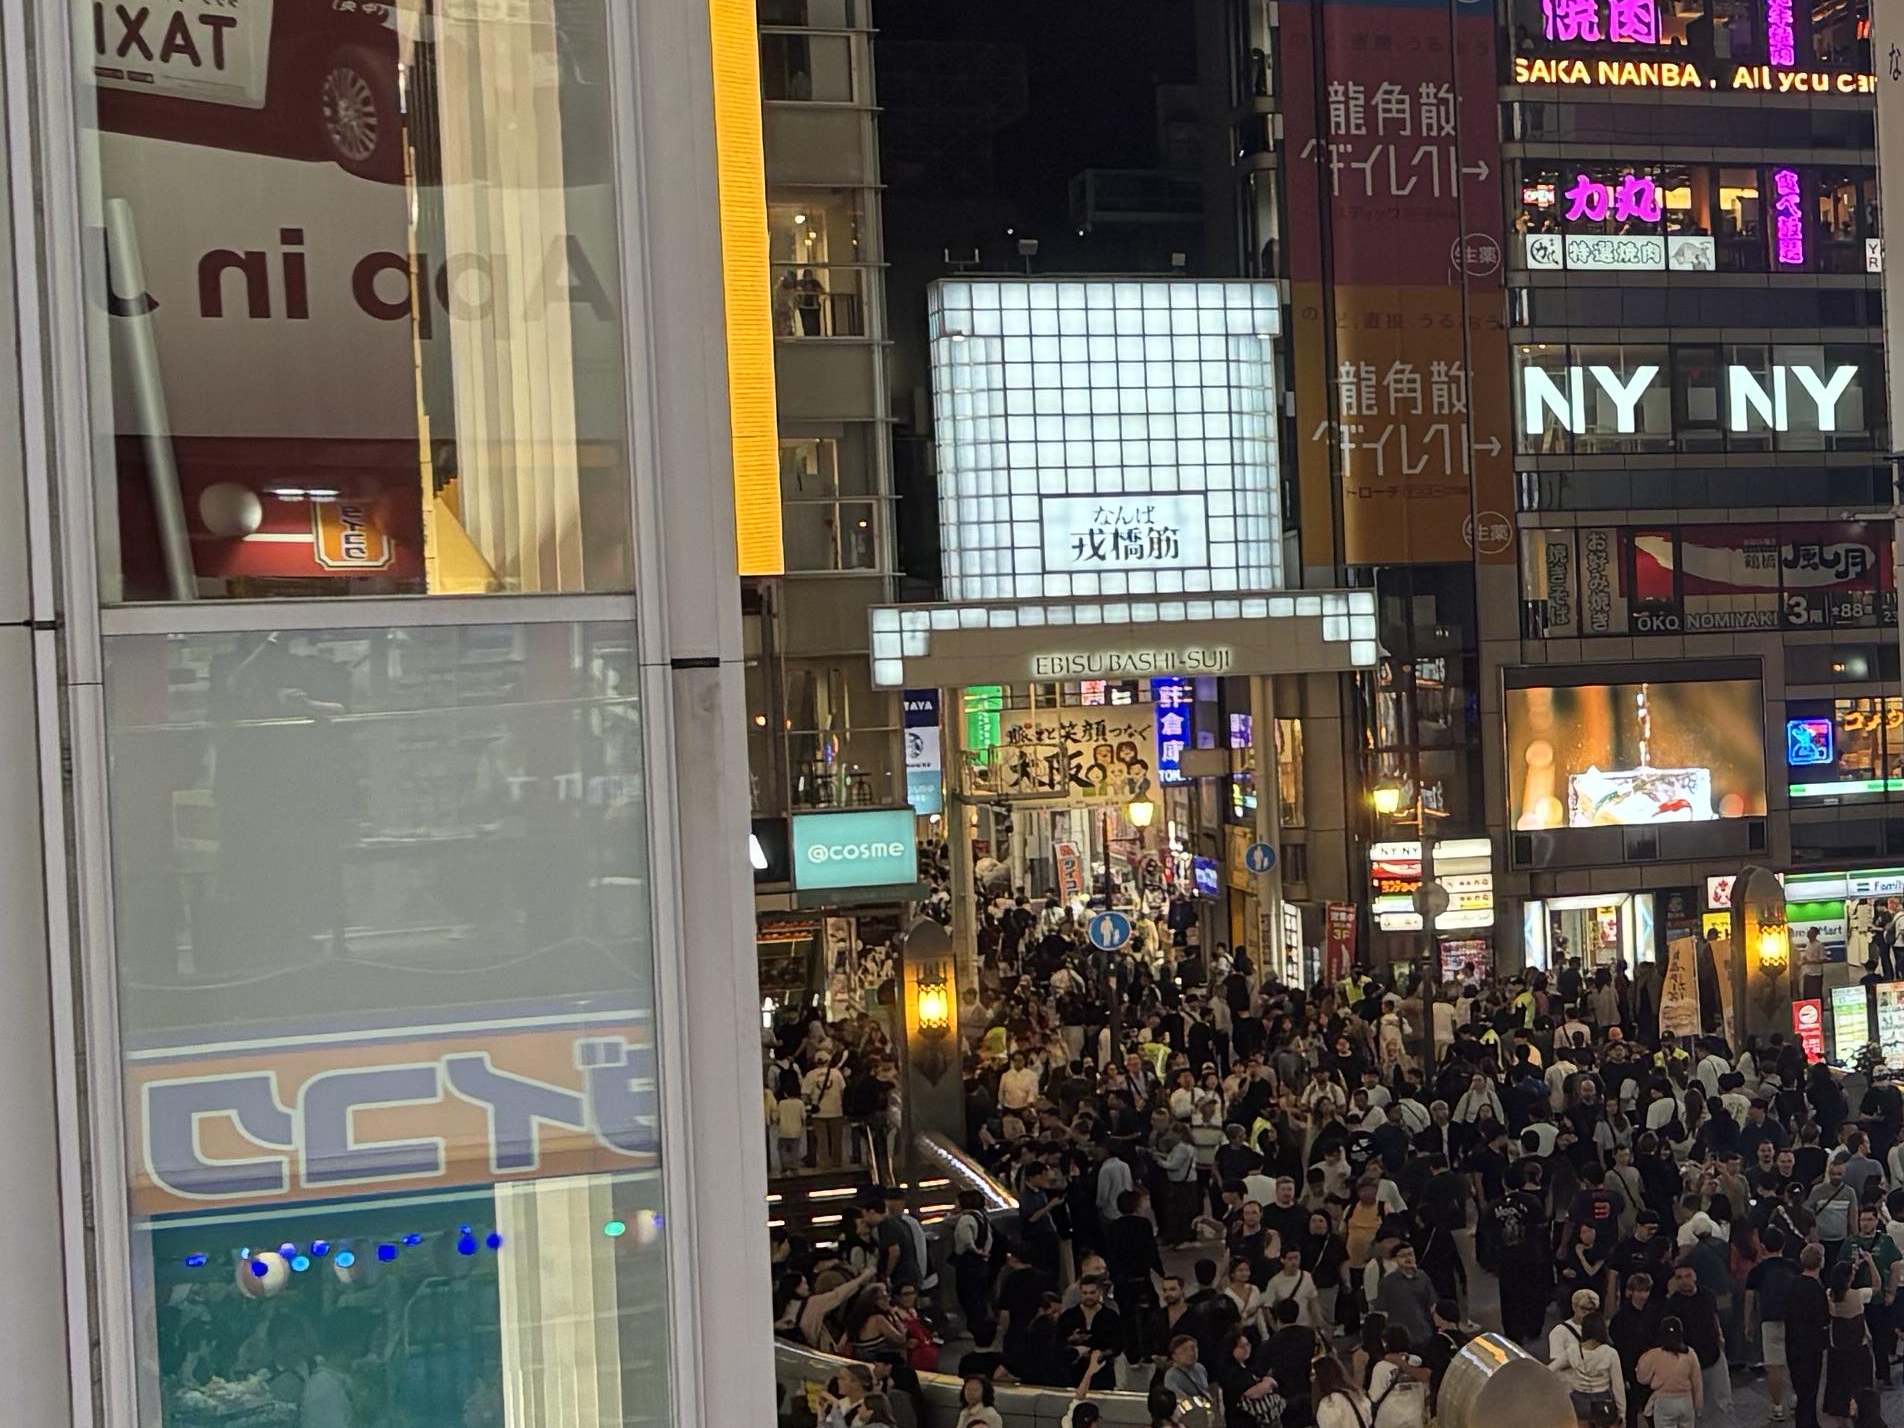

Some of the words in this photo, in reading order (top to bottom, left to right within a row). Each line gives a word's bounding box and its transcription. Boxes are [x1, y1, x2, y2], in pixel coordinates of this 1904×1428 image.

[1598, 61, 1701, 88] NANBA
[1327, 80, 1457, 137] 龍角散
[1564, 174, 1662, 223] 力丸
[1336, 359, 1474, 417] 龍角散
[1524, 364, 1660, 435] NY
[1728, 364, 1859, 432] NY
[1091, 504, 1156, 527] なんば
[807, 841, 905, 864] @cosme
